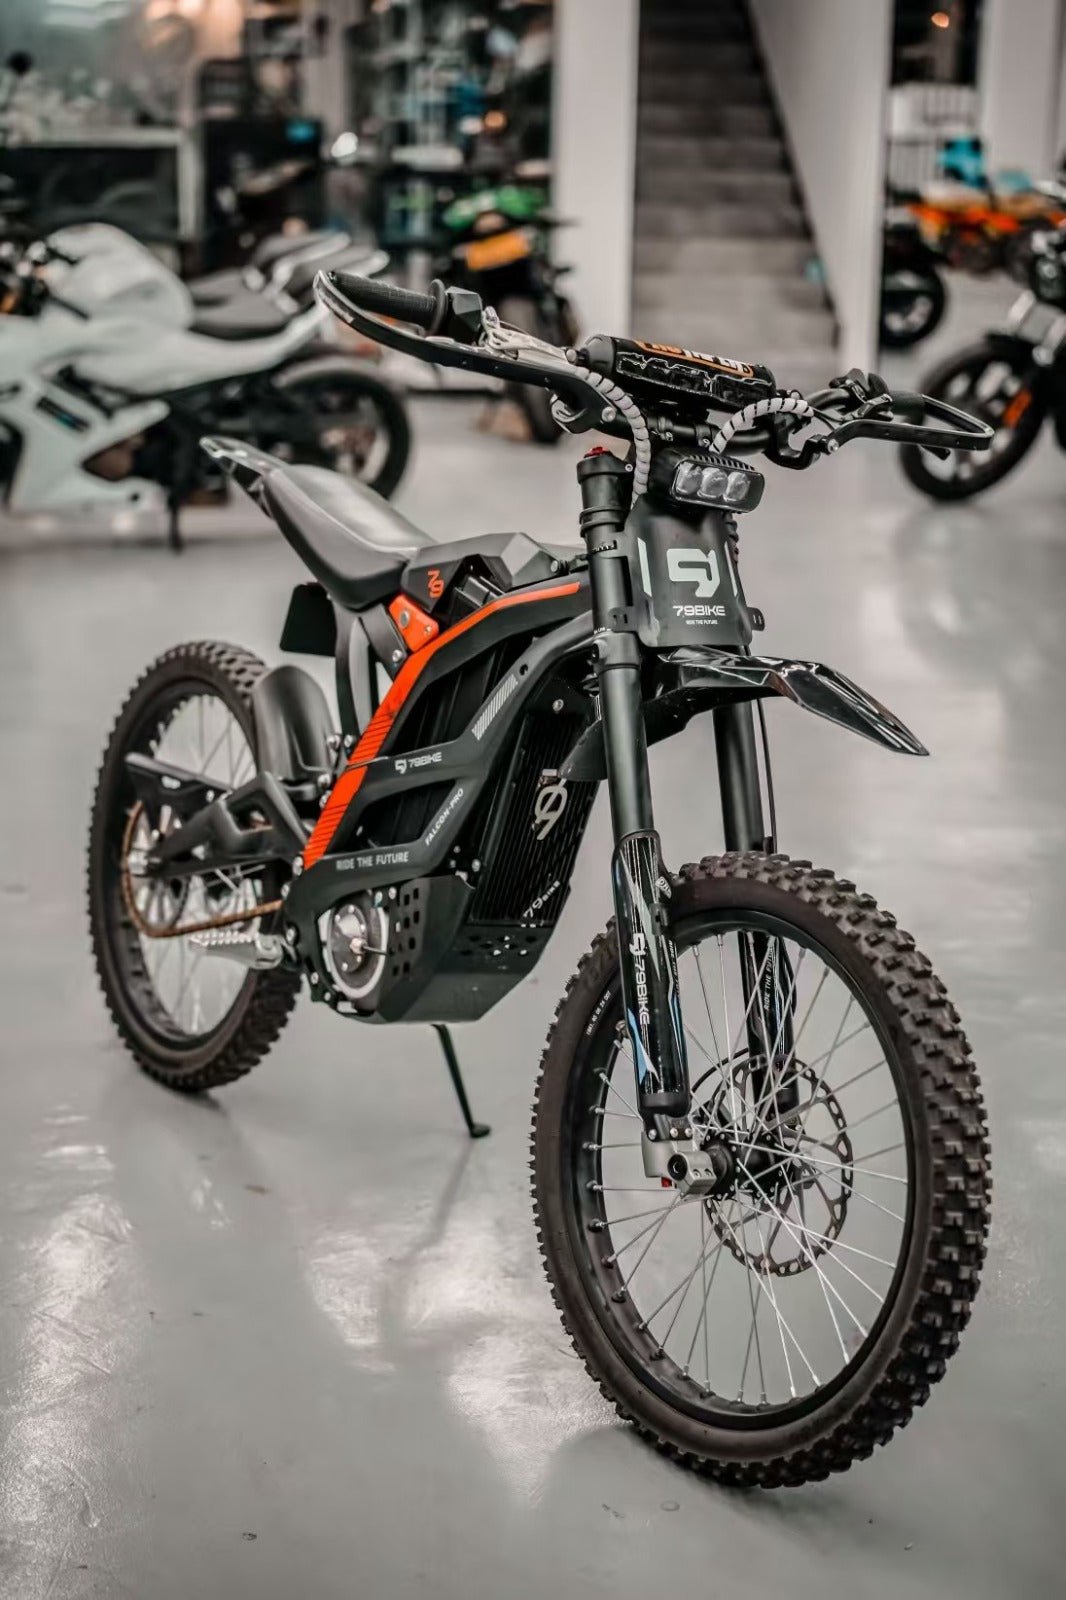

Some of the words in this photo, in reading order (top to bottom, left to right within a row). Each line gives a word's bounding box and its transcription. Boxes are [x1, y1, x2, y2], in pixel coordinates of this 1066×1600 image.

[427, 570, 445, 599] 79
[672, 605, 726, 617] 79BIKE
[408, 752, 442, 768] 79BIKE
[424, 788, 464, 846] FALCON-PRO
[336, 858, 355, 870] RIDE
[357, 856, 373, 868] THE
[376, 852, 409, 864] FUTURE
[523, 880, 561, 918] 79BIKE
[634, 959, 650, 1025] 79BIKE
